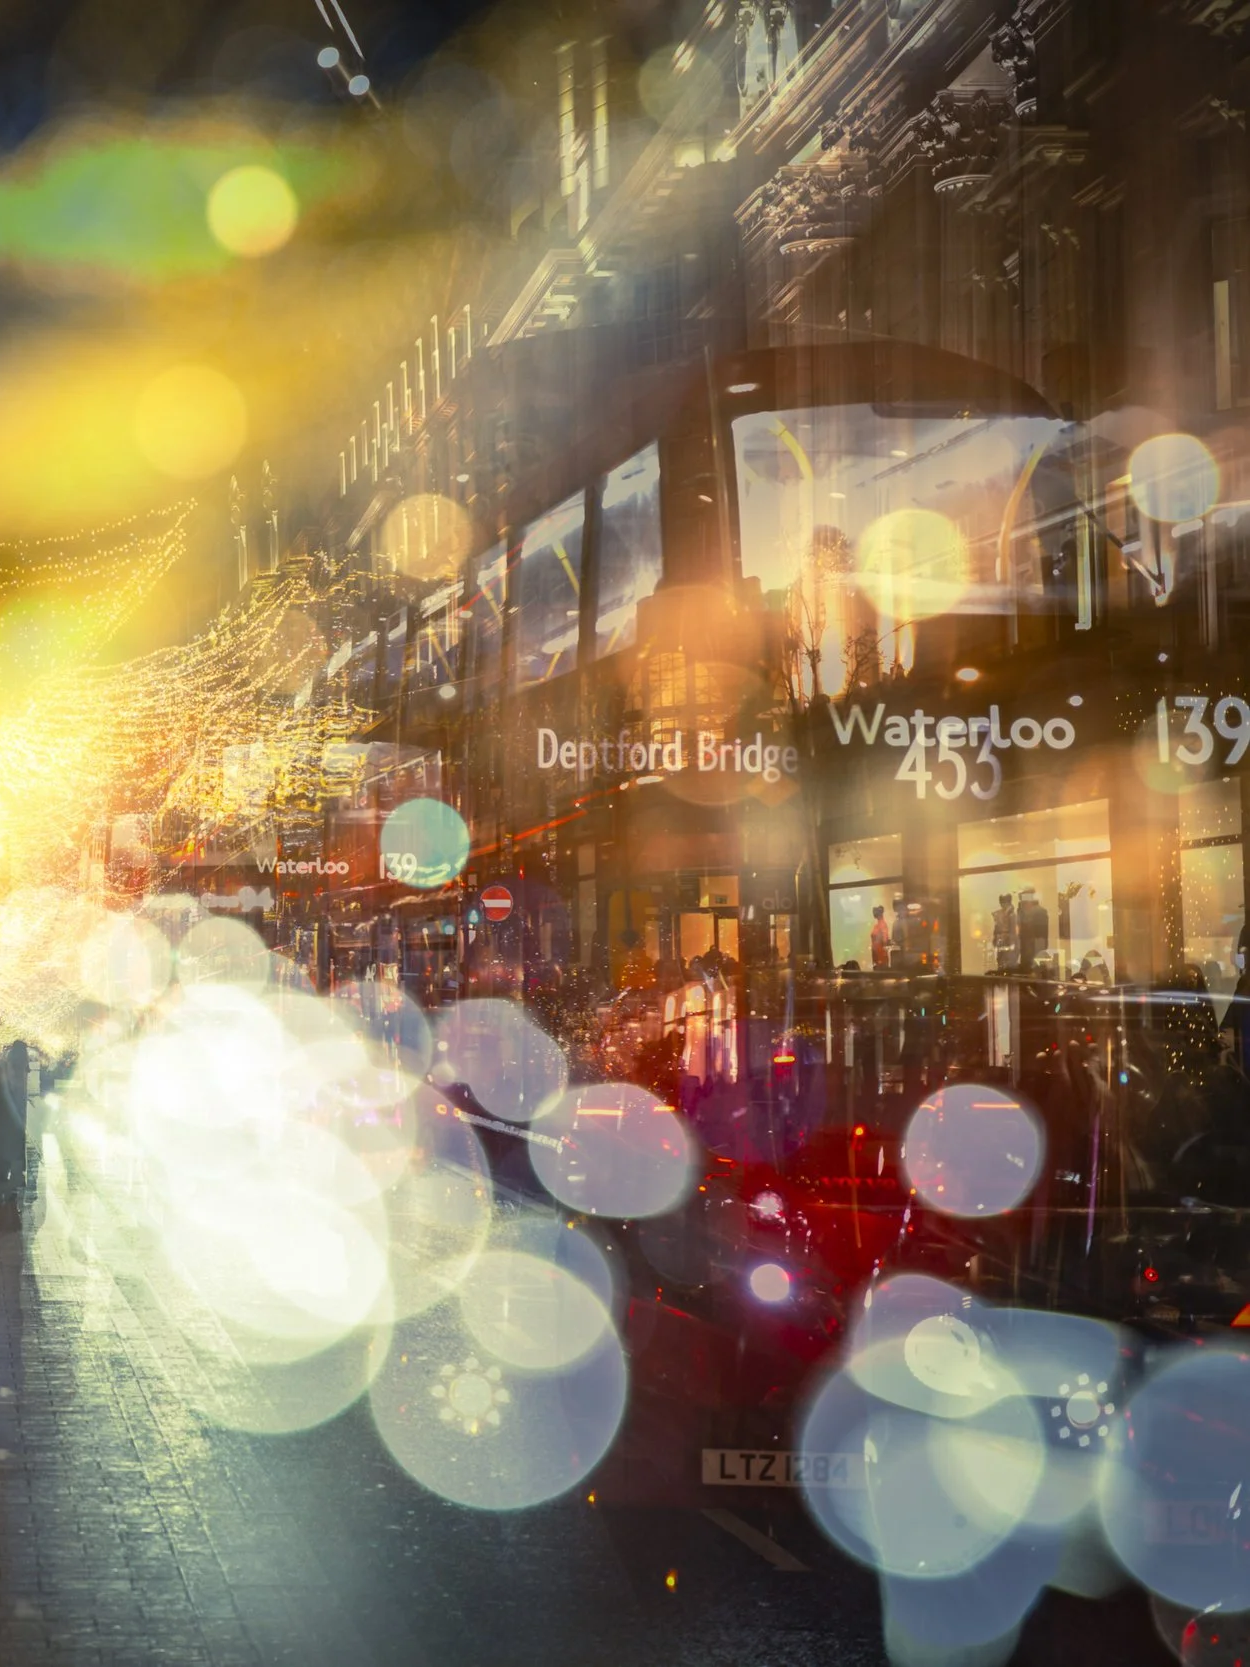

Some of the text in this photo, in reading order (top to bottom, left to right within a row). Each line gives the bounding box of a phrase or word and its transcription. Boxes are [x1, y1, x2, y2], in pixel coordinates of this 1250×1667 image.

[827, 703, 1076, 750] Waterloo
[1157, 696, 1250, 765] 139
[537, 728, 799, 783] Deptford Bridge
[894, 722, 1002, 800] 453
[256, 853, 417, 880] Waterloo 139
[719, 1453, 776, 1481] LTZ
